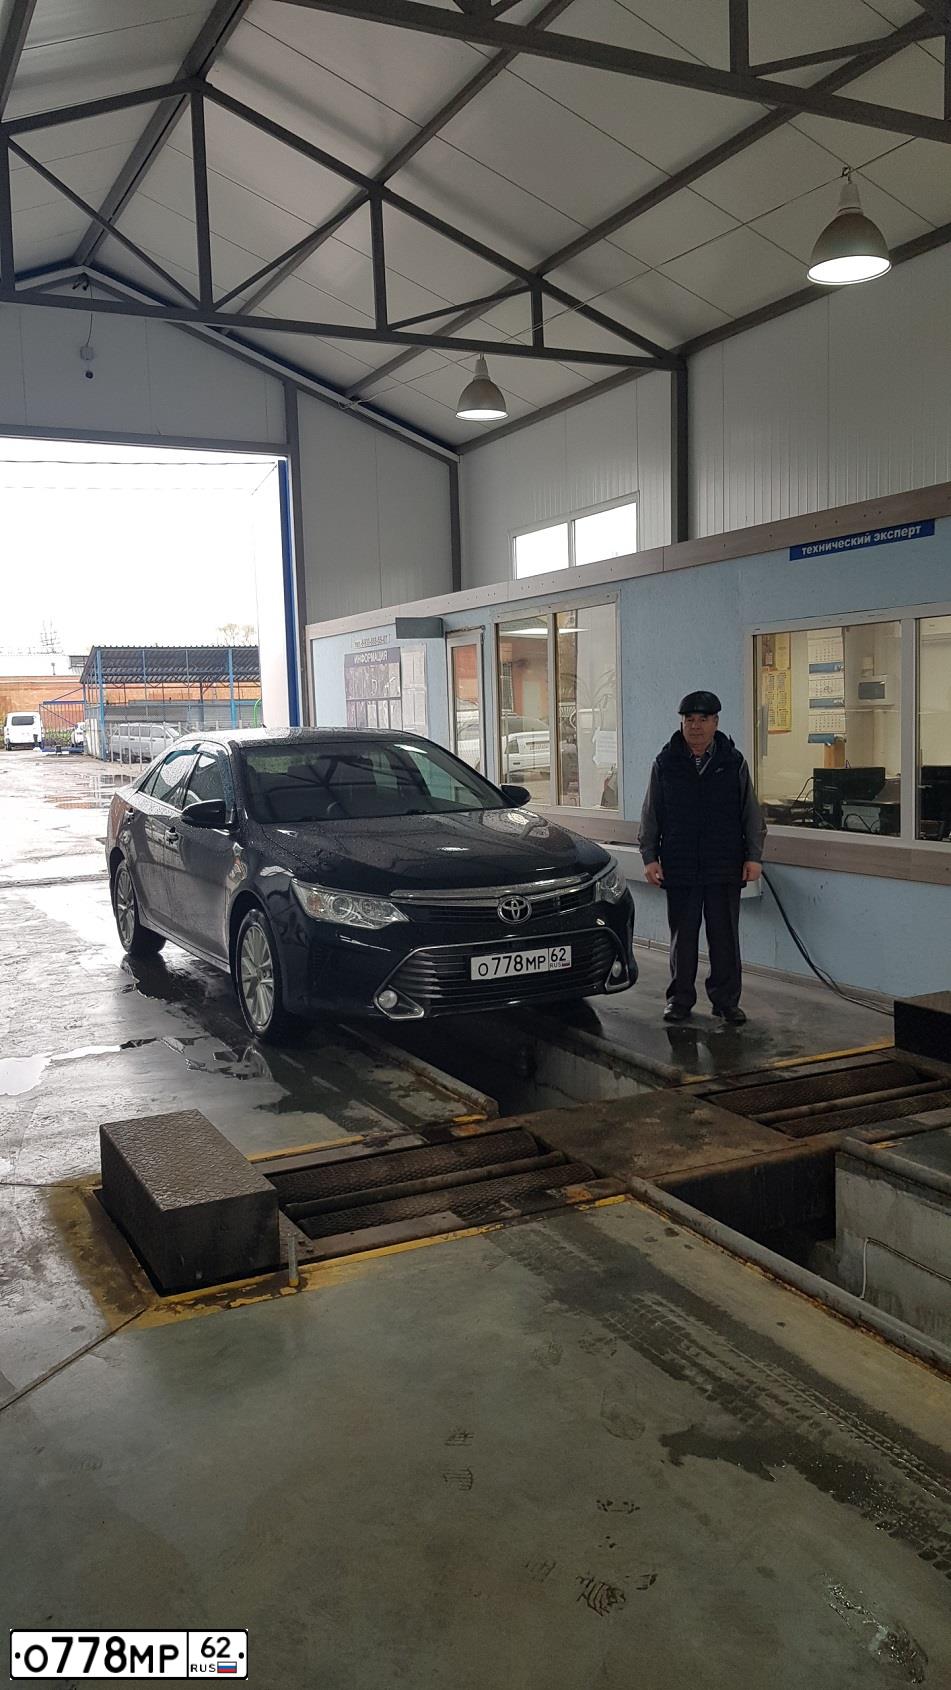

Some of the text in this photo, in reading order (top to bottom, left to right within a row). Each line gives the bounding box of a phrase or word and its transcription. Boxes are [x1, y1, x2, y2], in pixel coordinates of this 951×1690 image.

[801, 525, 922, 555] технический эксперт
[353, 649, 388, 664] ИНФОРМАЦИЯ
[478, 947, 567, 977] О778МР 62
